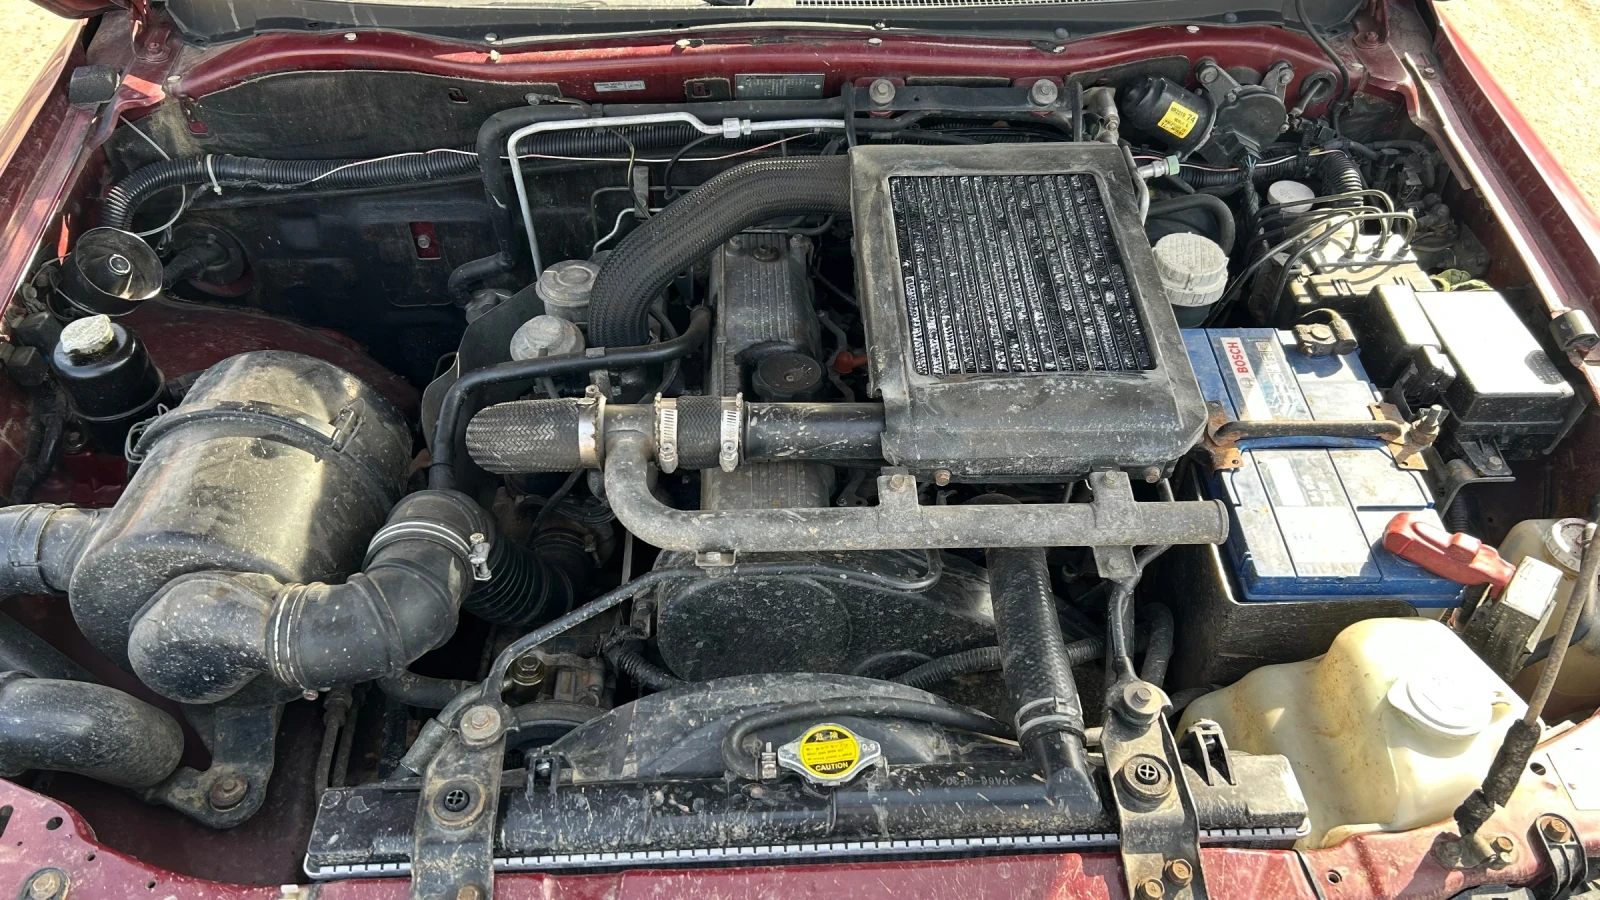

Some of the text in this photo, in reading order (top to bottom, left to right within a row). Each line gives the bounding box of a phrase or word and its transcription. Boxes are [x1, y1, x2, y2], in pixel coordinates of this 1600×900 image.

[1186, 113, 1196, 123] 74
[1227, 342, 1249, 373] BOSCH
[862, 743, 875, 752] 0.9
[815, 761, 849, 771] CAUTION
